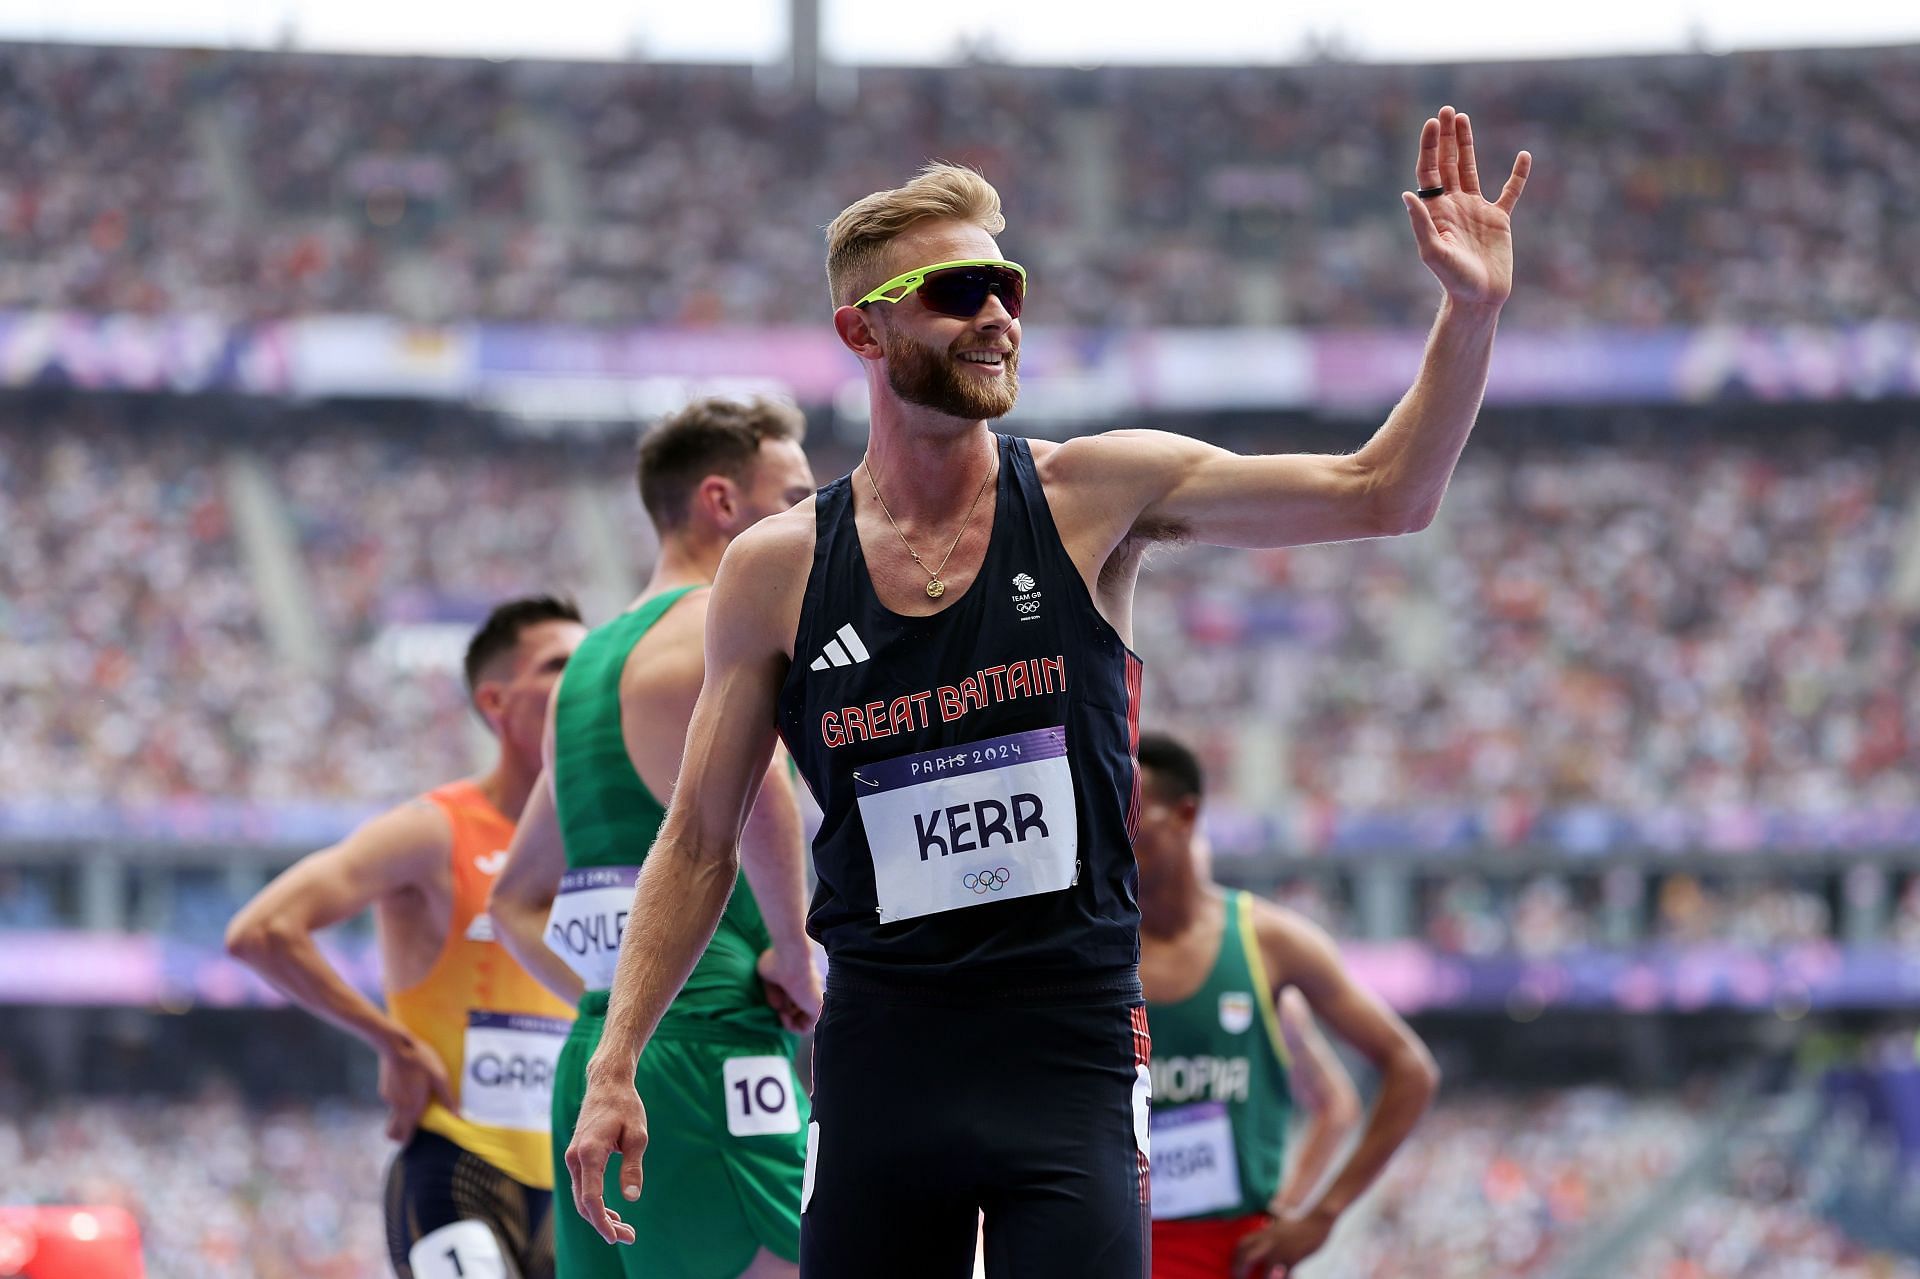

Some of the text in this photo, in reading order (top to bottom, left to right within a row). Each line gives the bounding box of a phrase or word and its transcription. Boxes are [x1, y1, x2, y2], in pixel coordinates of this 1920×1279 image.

[1012, 591, 1042, 602] TEAM GB
[821, 655, 1067, 748] GREAT BRITAIN
[911, 743, 1021, 776] PARIS 2024
[913, 793, 1049, 861] KERR
[471, 1051, 554, 1092] GAR
[735, 1076, 785, 1116] 10
[446, 1247, 464, 1277] 1
